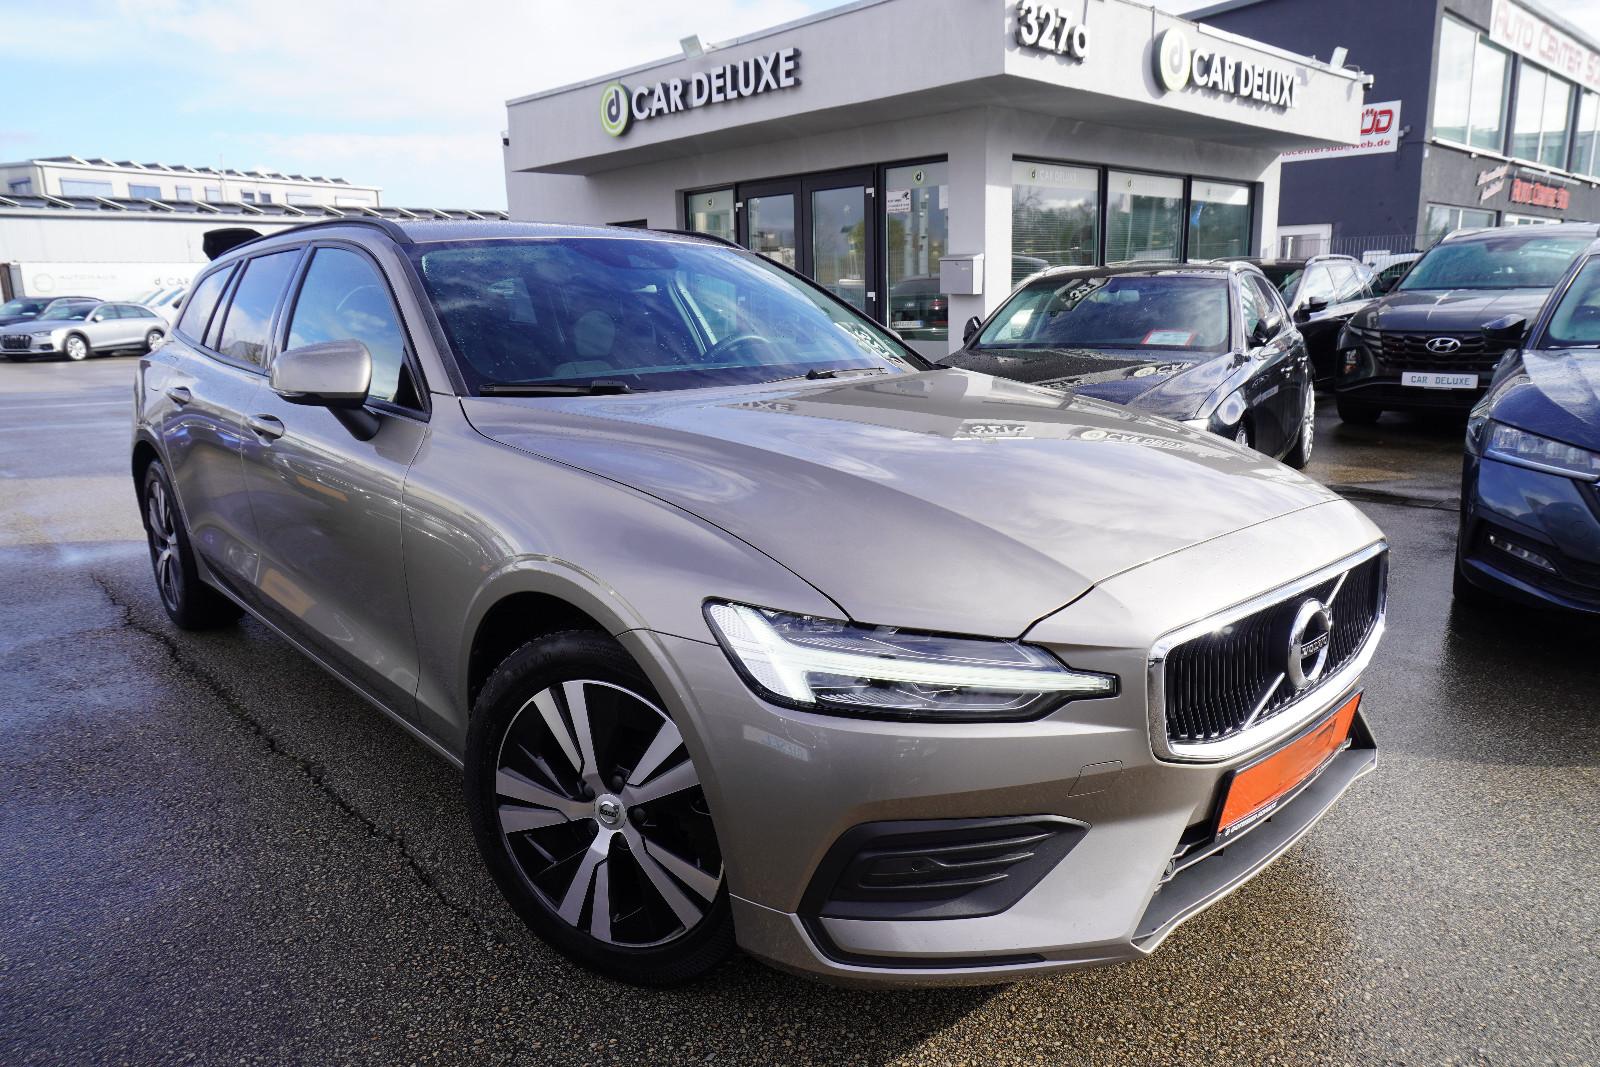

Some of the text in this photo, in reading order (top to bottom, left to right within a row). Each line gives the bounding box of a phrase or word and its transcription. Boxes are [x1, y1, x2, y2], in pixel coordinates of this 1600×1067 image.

[632, 78, 686, 121] CAR
[692, 47, 798, 108] DELUXE
[1192, 49, 1235, 92] CAR
[1411, 375, 1471, 386] CAR DELUXE
